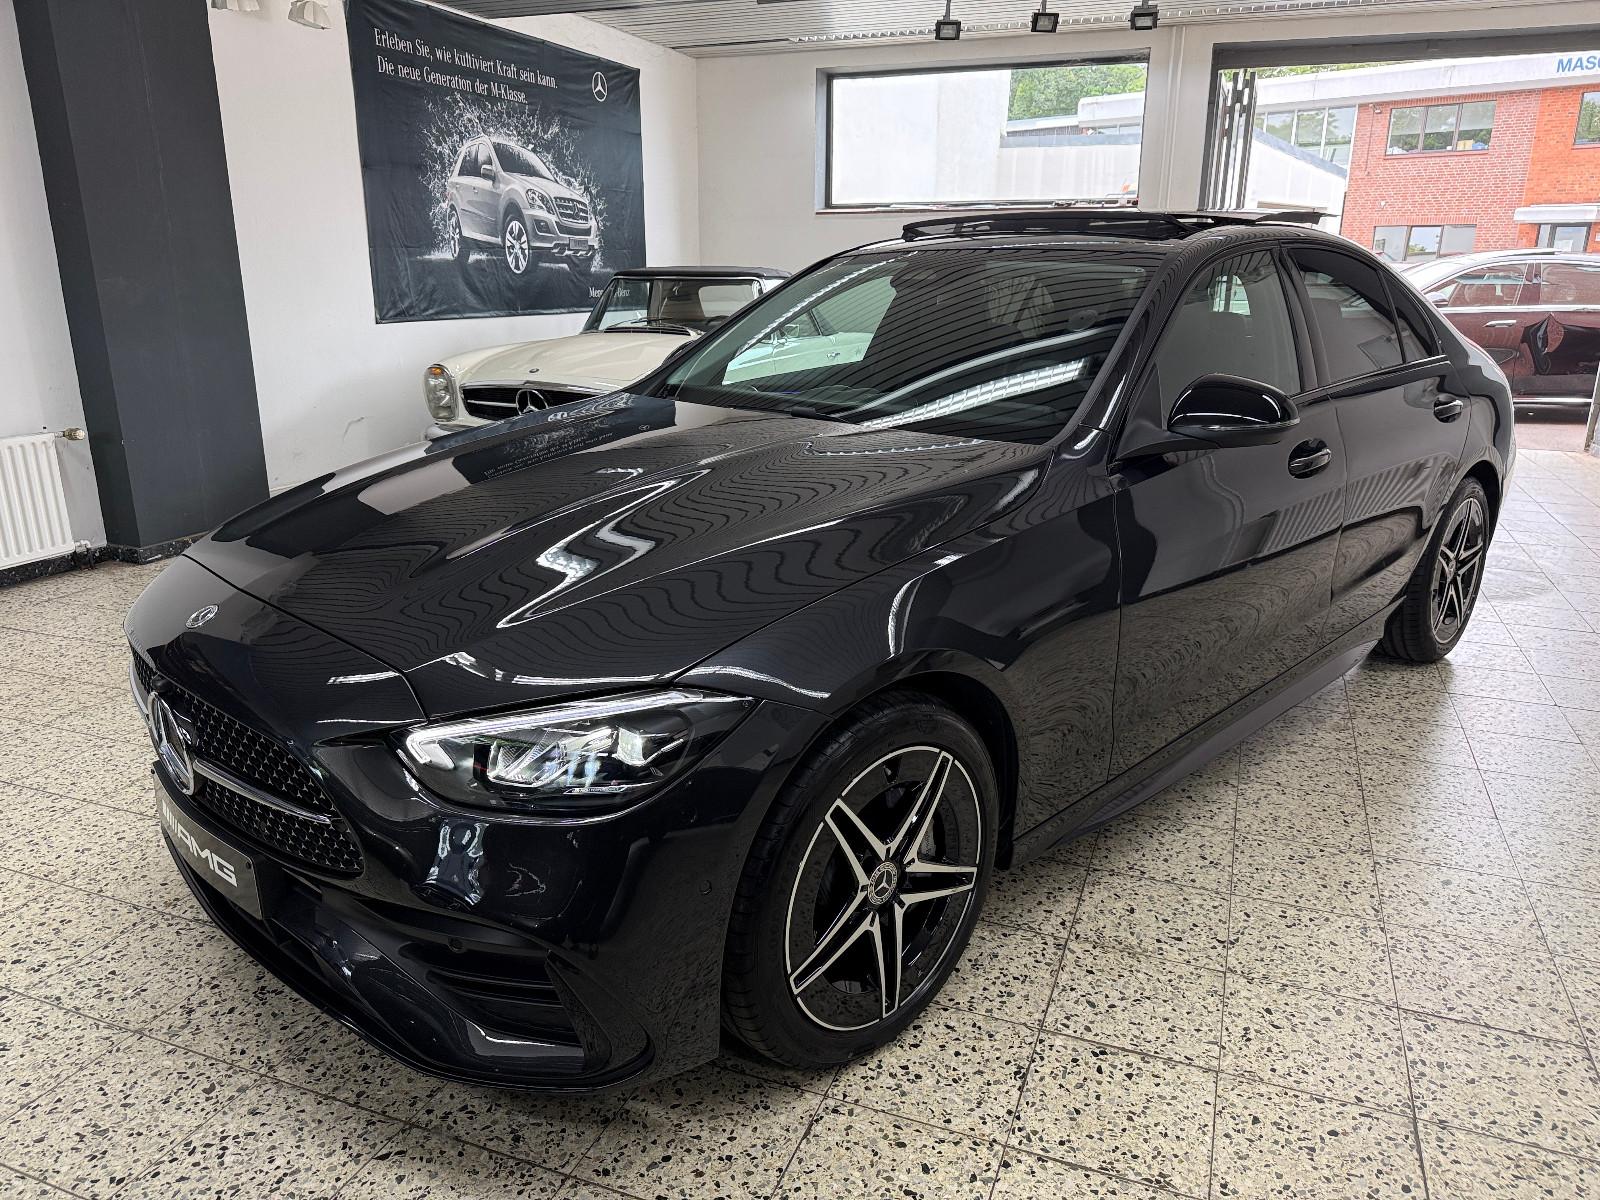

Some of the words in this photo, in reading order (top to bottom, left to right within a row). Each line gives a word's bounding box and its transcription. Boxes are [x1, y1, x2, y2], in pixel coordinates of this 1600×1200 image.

[374, 28, 413, 54] Erleben
[415, 39, 433, 62] Sie,
[435, 46, 452, 63] wie
[453, 48, 495, 74] kultiviert
[496, 60, 518, 80] Kraft
[520, 68, 535, 84] sein
[537, 70, 558, 89] kann.
[378, 55, 395, 75] Die
[398, 64, 420, 81] neue
[423, 66, 472, 92] Generation
[474, 78, 488, 96] der
[490, 81, 528, 104] M-Klasse.
[1557, 55, 1600, 72] MAS
